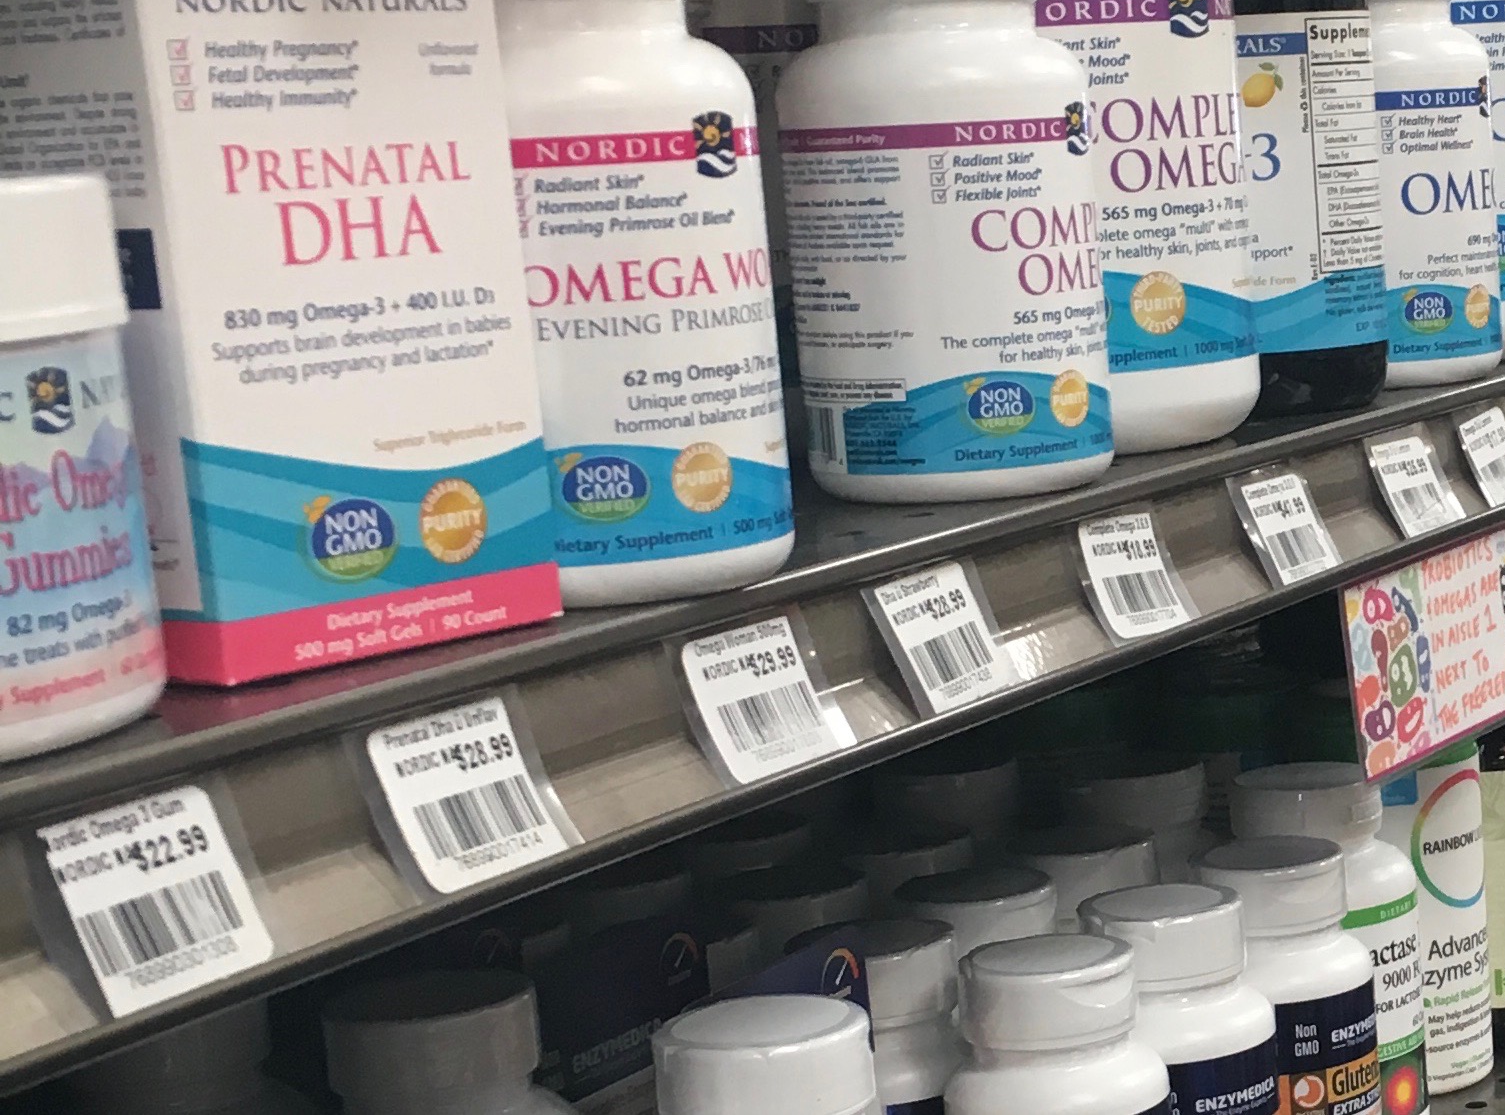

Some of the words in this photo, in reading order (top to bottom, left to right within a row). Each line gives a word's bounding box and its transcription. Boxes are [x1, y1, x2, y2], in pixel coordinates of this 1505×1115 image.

[204, 40, 267, 61] Healthy
[208, 65, 249, 83] Fetal
[212, 90, 274, 111] Healthy
[1401, 90, 1476, 108] NORDIC
[954, 120, 1062, 142] NORDIC
[1398, 115, 1436, 127] Healthy
[1399, 129, 1425, 139] Brain
[536, 136, 687, 163] NORDIC
[1399, 141, 1439, 154] Optimal
[220, 140, 473, 196] PRENATAL
[953, 154, 1004, 168] Radiant
[534, 177, 601, 194] Radiant
[954, 170, 1003, 185] Positive
[955, 187, 1003, 202] Flexible
[537, 197, 621, 215] Hormonal
[1102, 205, 1130, 222] 565
[1161, 201, 1214, 218] Omega-3
[275, 193, 444, 268] DHA
[538, 219, 604, 237] Evening
[609, 215, 676, 233] Primrose
[680, 211, 698, 228] Oil
[1133, 224, 1177, 242] omega
[1115, 240, 1165, 260] healthy
[1428, 253, 1460, 266] Perfect
[224, 310, 262, 329] 830
[303, 297, 385, 323] Omega-3
[1133, 295, 1184, 314] PURITY
[536, 313, 662, 342] EVENING
[671, 302, 765, 333] PRIMROSE
[1013, 310, 1039, 326] 565
[212, 338, 290, 363] Supports
[294, 333, 337, 352] brain
[342, 322, 443, 350] development
[465, 314, 512, 336] babies
[941, 335, 968, 350] The
[972, 332, 1034, 350] complete
[1037, 328, 1073, 344] omega
[1393, 342, 1432, 355] Dietary
[1434, 338, 1484, 353] Supplement
[239, 362, 298, 384] during
[302, 353, 387, 380] pregnancy
[391, 347, 420, 367] and
[999, 349, 1019, 364] for
[1022, 347, 1064, 365] healthy
[623, 369, 648, 387] 62
[627, 392, 687, 413] Unique
[691, 387, 737, 407] omega
[979, 387, 1022, 404] NON
[614, 412, 695, 434] hormonal
[699, 406, 748, 427] balance
[979, 401, 1024, 419] GMO
[954, 445, 1005, 463] Dietary
[1008, 438, 1078, 459] Supplement
[575, 463, 631, 484] NON
[674, 467, 730, 487] PURITY
[575, 480, 634, 502] GMO
[324, 508, 378, 534] NON
[422, 509, 483, 534] PURITY
[325, 527, 382, 557] GMO
[615, 526, 714, 551] Supplement
[1421, 536, 1494, 588] PROBIOTICS
[327, 607, 382, 630] Dietary
[386, 590, 473, 620] Supplement
[464, 606, 507, 628] Count
[1431, 630, 1445, 653] IN
[1447, 616, 1480, 646] AISLE
[1483, 603, 1498, 633] 1
[1434, 659, 1467, 692] NEXT
[1471, 648, 1490, 674] TO
[1437, 699, 1460, 733] THE
[1422, 833, 1473, 856] RAINBOW
[1382, 966, 1411, 993] 9000
[1295, 1023, 1318, 1040] Non
[1195, 1075, 1276, 1114] ENZYMEDICA
